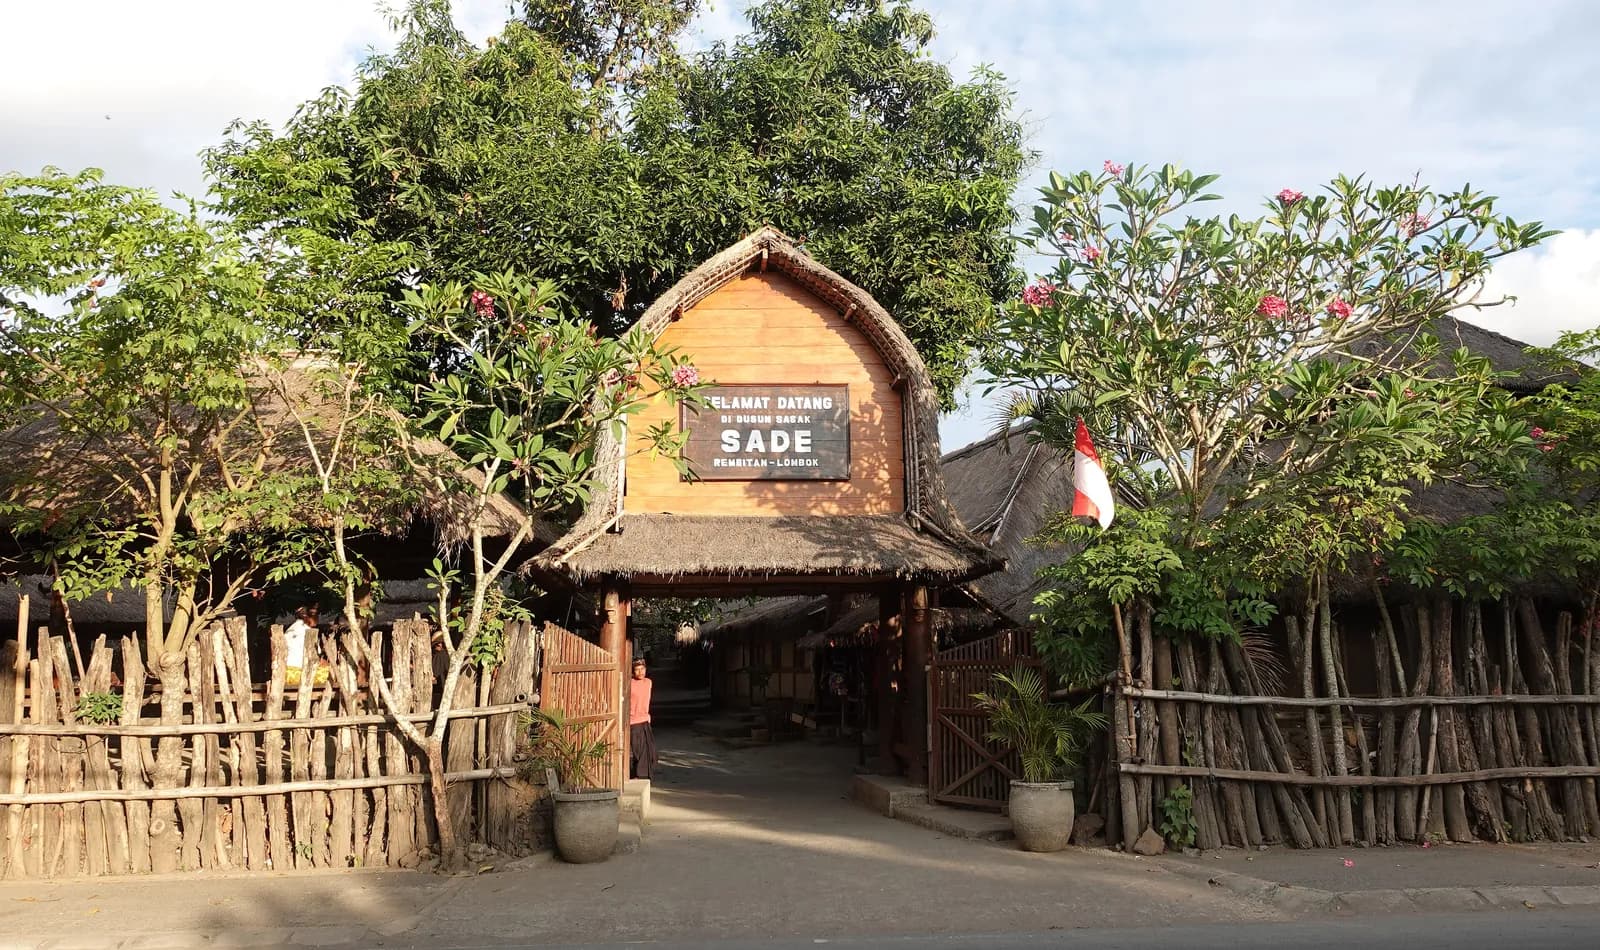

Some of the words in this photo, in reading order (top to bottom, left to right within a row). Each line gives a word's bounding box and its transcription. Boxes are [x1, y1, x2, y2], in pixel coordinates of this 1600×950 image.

[777, 396, 833, 410] DATANG
[720, 415, 731, 424] DI
[736, 415, 772, 424] DUSUN
[775, 415, 811, 424] SASAK
[720, 429, 812, 453] SADE
